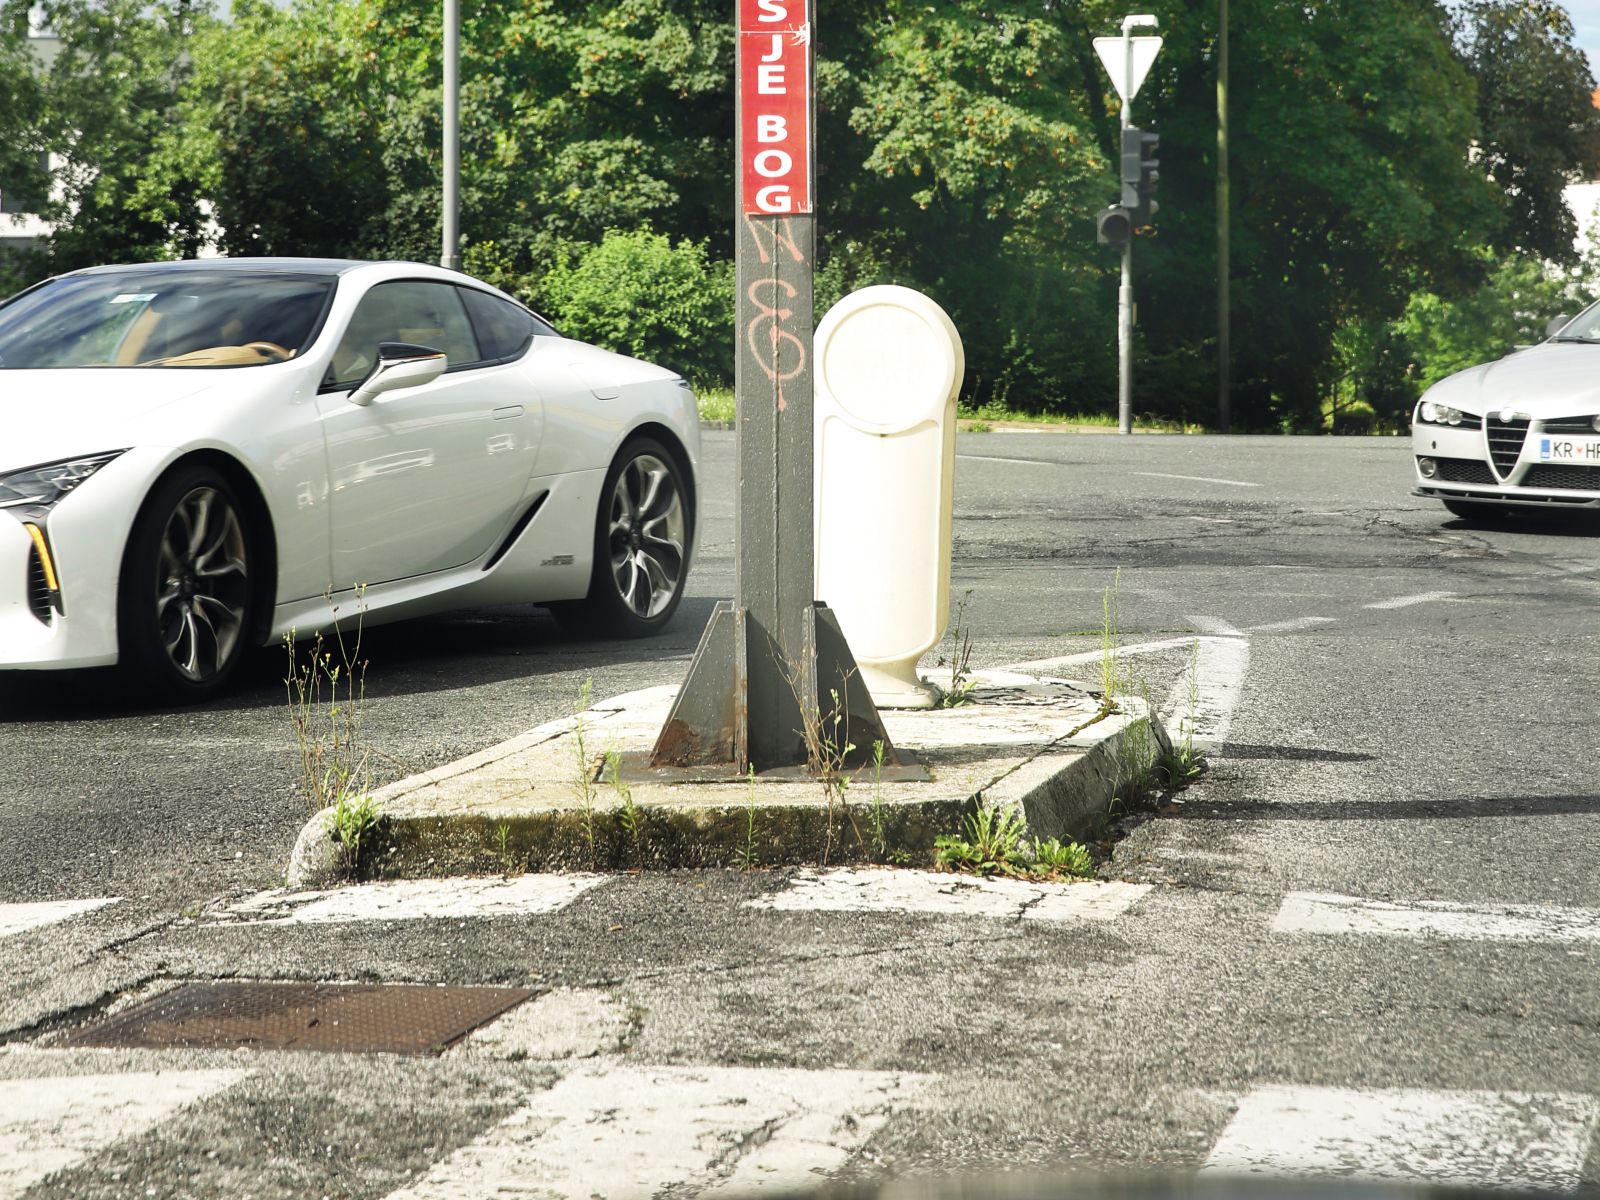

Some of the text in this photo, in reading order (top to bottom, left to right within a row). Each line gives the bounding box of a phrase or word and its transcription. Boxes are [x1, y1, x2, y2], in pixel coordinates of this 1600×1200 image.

[757, 34, 786, 95] JE
[753, 114, 793, 213] BOG
[1553, 442, 1573, 458] KR
